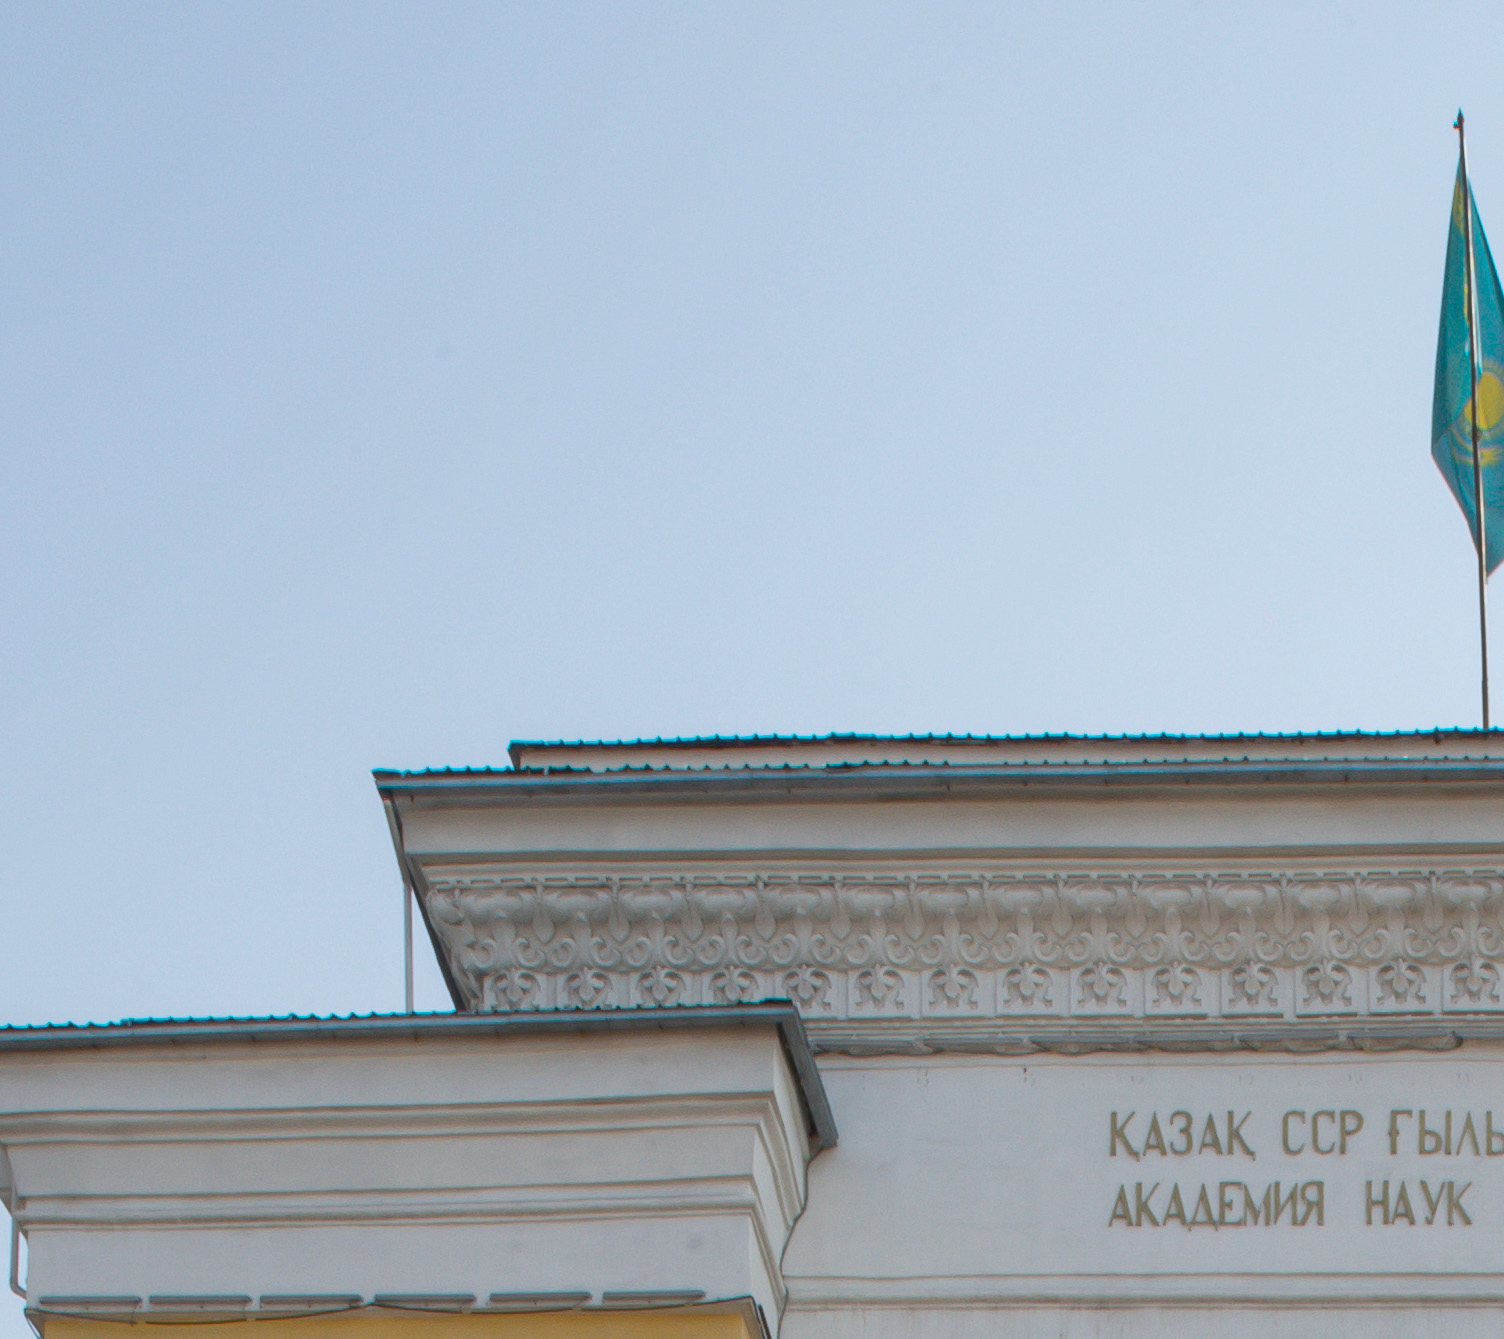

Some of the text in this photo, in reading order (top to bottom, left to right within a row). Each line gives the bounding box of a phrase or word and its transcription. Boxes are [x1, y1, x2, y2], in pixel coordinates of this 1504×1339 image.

[1109, 1110, 1256, 1162] ҚАЗАҚ
[1282, 1109, 1364, 1156] ССР
[1108, 1180, 1324, 1232] АКАДЕМИЯ
[1365, 1180, 1472, 1226] НАУК
